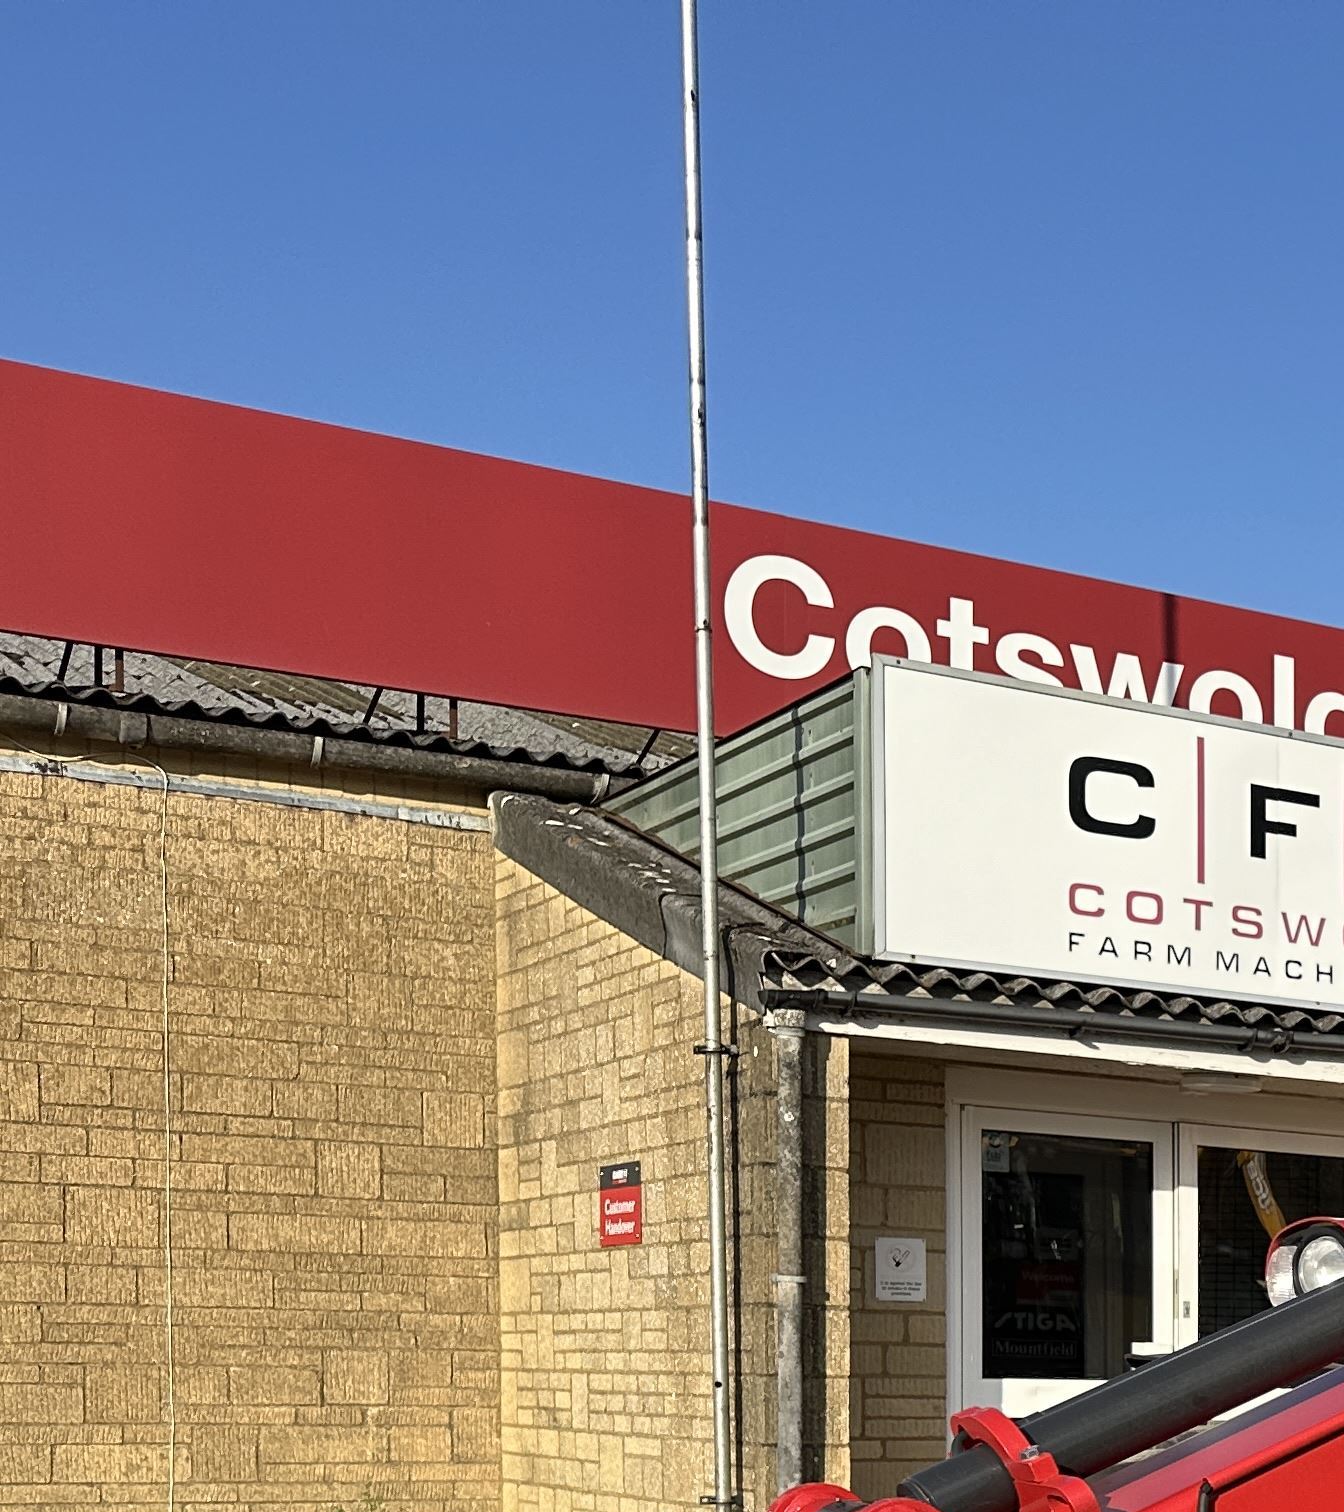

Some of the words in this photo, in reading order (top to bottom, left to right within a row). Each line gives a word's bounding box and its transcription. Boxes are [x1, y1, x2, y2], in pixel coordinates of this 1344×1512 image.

[1068, 932, 1192, 967] FARM
[994, 1312, 1077, 1331] STIGA
[994, 1339, 1076, 1356] Mountfield
